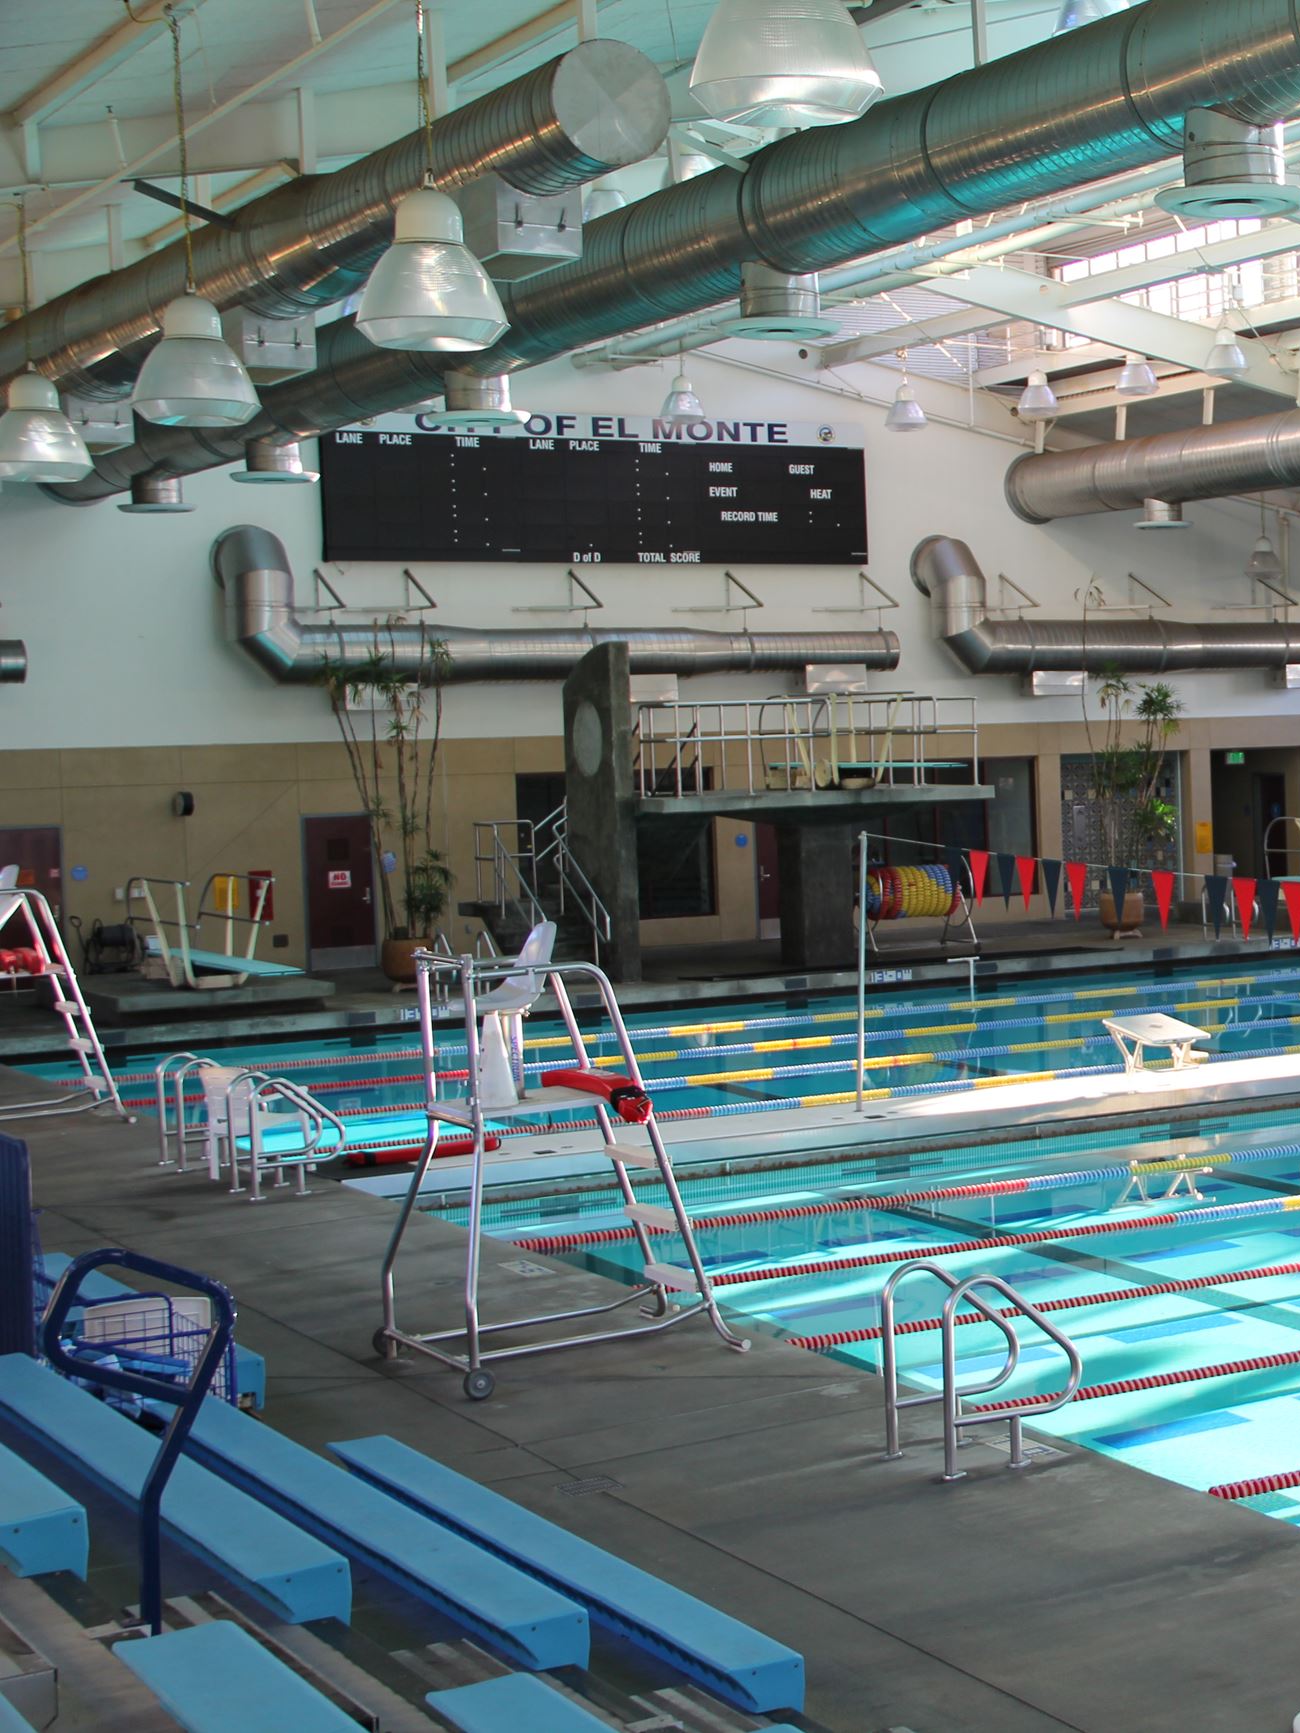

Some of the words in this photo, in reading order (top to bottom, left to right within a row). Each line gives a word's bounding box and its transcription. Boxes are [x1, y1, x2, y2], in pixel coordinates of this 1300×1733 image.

[523, 413, 577, 437] OF
[591, 415, 640, 439] EL
[651, 418, 789, 444] MONTE
[335, 431, 364, 445] LANE
[378, 433, 412, 446] PLACE
[454, 435, 480, 448] TIME
[528, 438, 555, 451] LANE
[568, 439, 600, 452] PLACE
[638, 441, 662, 454] TIME
[708, 461, 733, 473] HOME
[788, 463, 815, 476] GUEST
[708, 485, 738, 498] EVENT
[809, 488, 833, 500] HEAT
[720, 510, 756, 523] RECORD
[756, 511, 778, 523] TIME
[573, 551, 581, 563] D
[582, 551, 592, 563] of
[593, 551, 601, 563] D
[637, 551, 667, 563] TOTAL
[669, 551, 701, 563] SCORE
